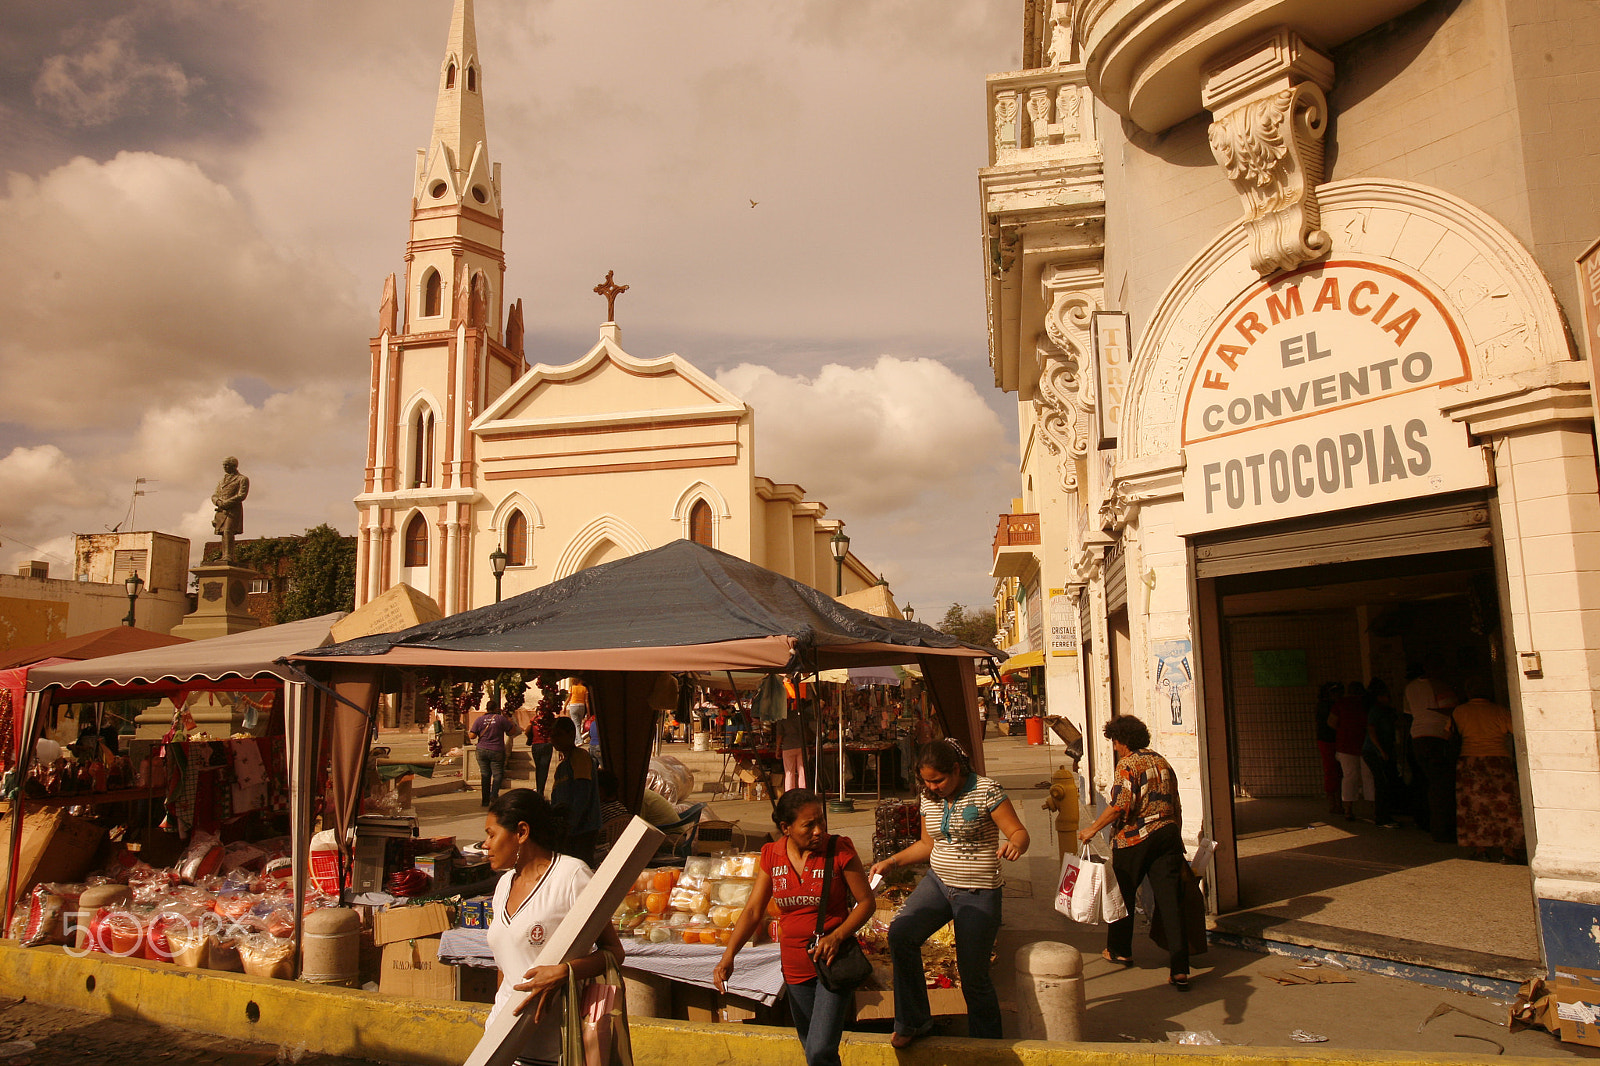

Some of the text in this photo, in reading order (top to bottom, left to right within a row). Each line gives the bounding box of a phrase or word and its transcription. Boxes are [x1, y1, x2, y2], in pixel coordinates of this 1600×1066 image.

[1202, 277, 1422, 391] FARMACIA
[1280, 331, 1331, 368] EL
[1202, 351, 1433, 432] CONVENTO
[1203, 419, 1432, 514] FOTOCOPIAS
[812, 869, 824, 879] TH
